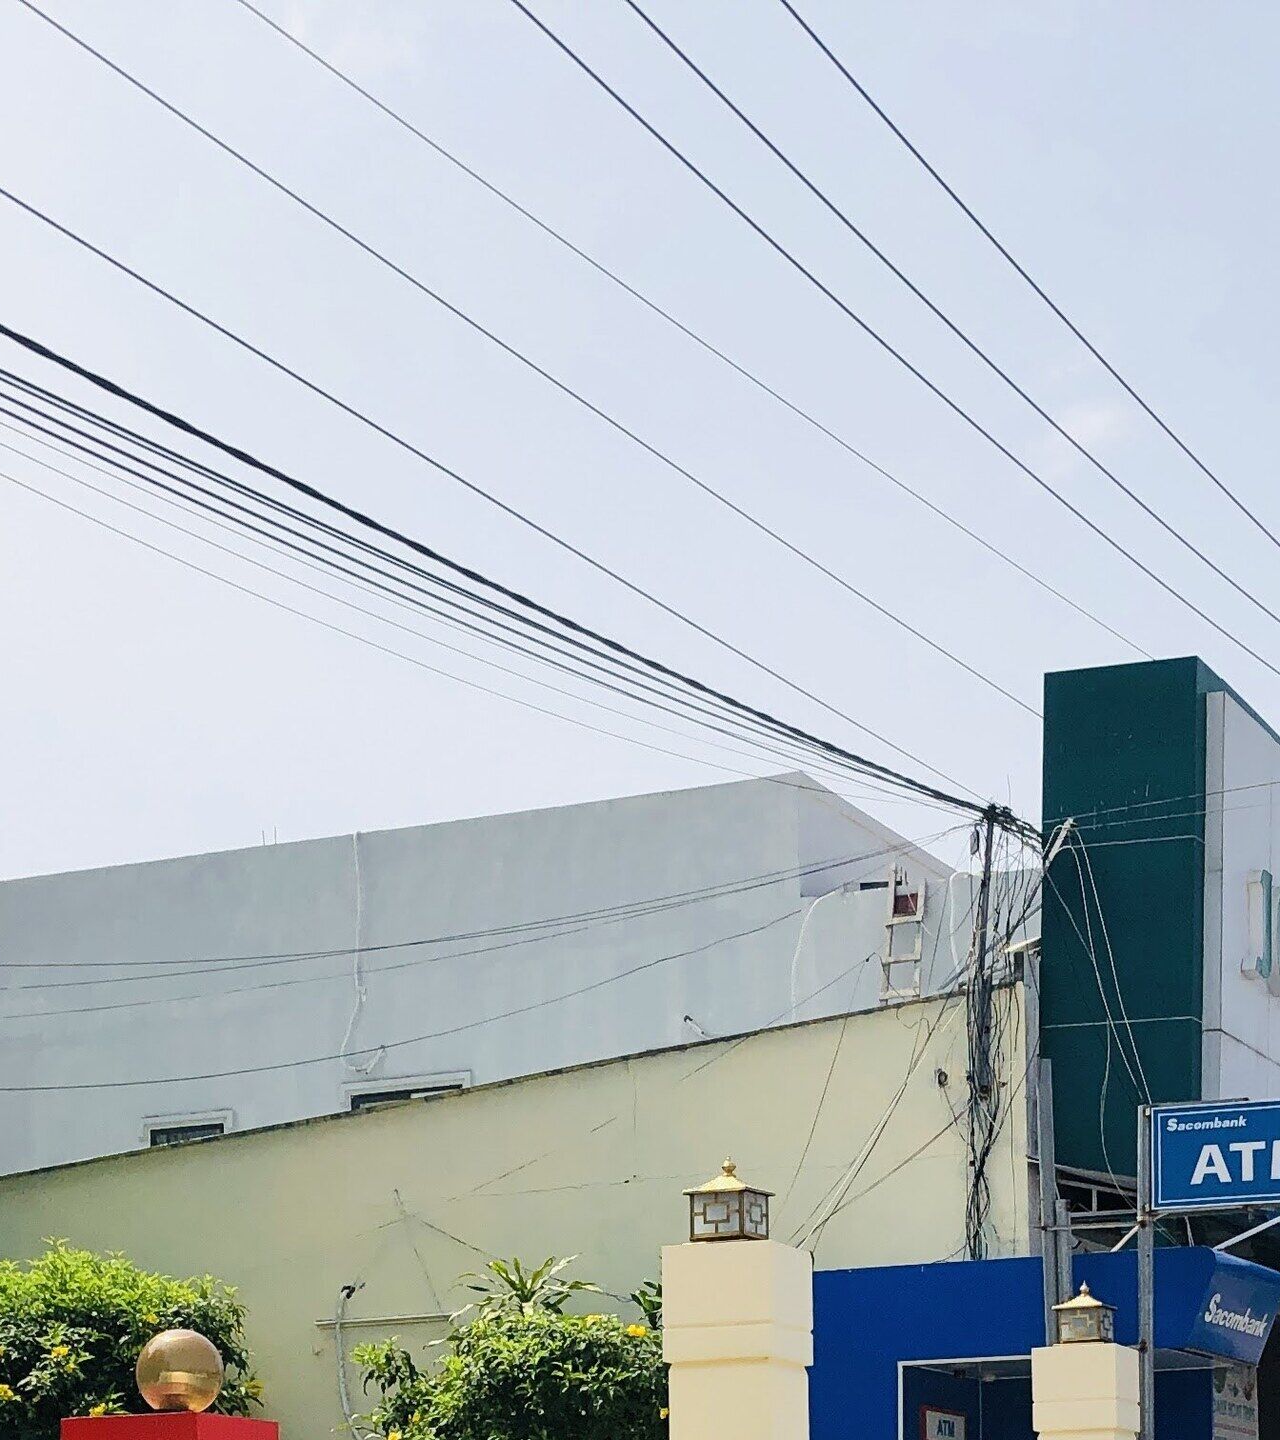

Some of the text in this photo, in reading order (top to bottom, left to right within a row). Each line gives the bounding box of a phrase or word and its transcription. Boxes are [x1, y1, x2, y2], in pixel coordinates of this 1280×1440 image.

[1167, 1115, 1248, 1132] Sacombank
[1205, 1293, 1268, 1337] Sacombank
[936, 1419, 955, 1438] ATM
